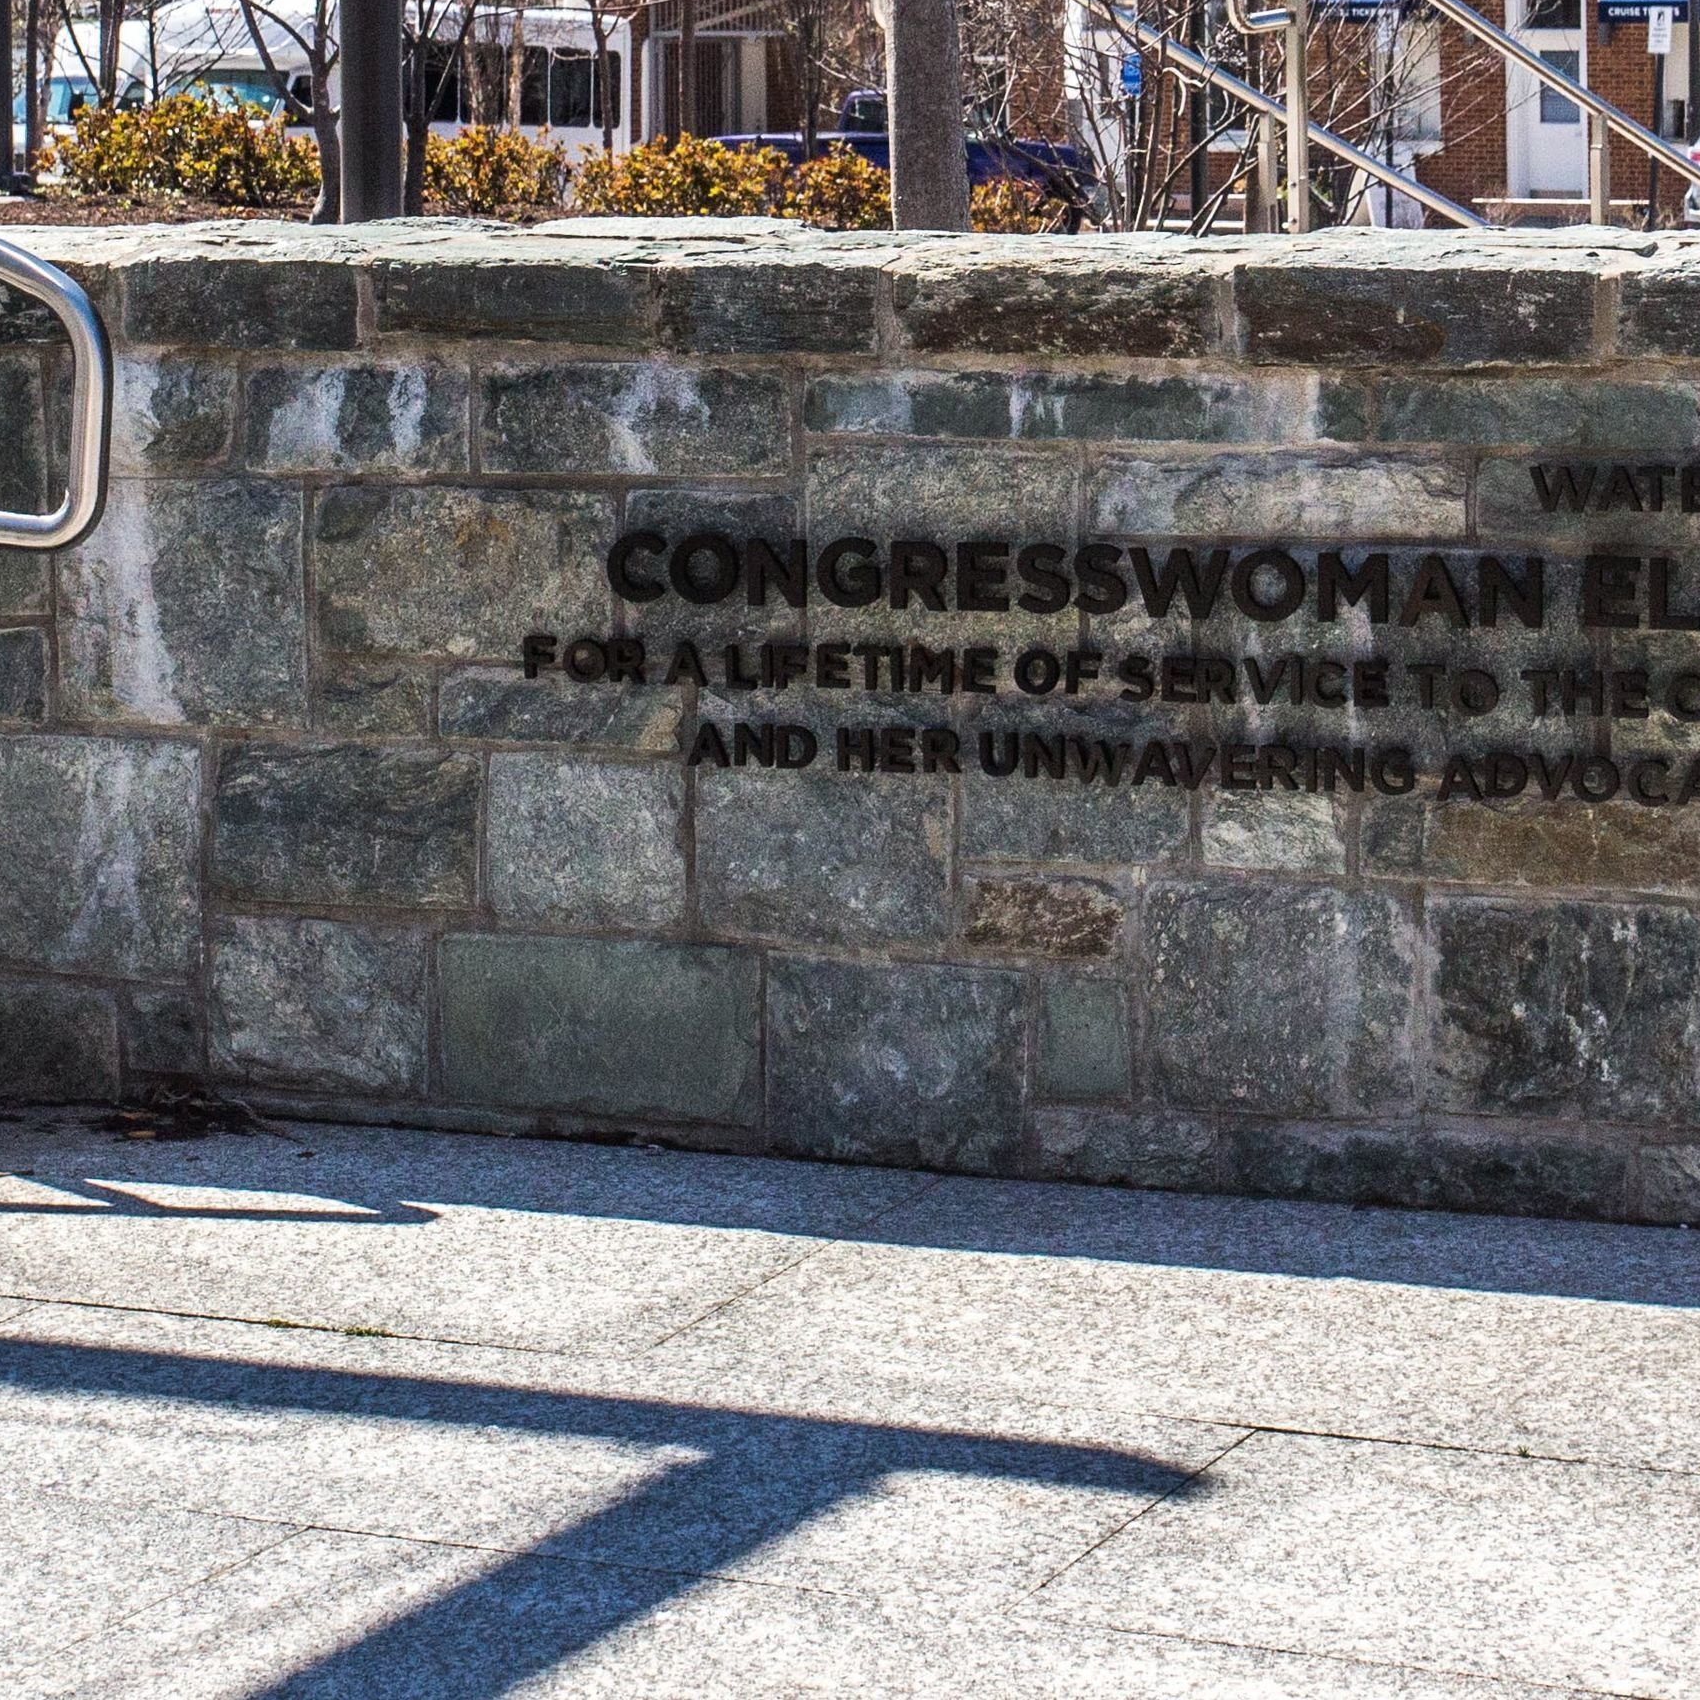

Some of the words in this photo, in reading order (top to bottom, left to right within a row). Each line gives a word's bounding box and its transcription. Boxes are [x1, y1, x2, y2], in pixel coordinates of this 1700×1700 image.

[1608, 7, 1640, 16] CRUISE
[606, 532, 1543, 628] CONGRESSWOMAN
[522, 635, 646, 684] FOR
[664, 641, 706, 687] A
[724, 642, 998, 695] LIFETIME
[1014, 648, 1103, 696] OF
[1116, 655, 1390, 710] SERVICE
[1406, 664, 1502, 717] TO
[1520, 669, 1649, 719] THE
[687, 722, 818, 769] AND
[836, 728, 962, 775] HER
[979, 732, 1416, 795] UNWAVERING
